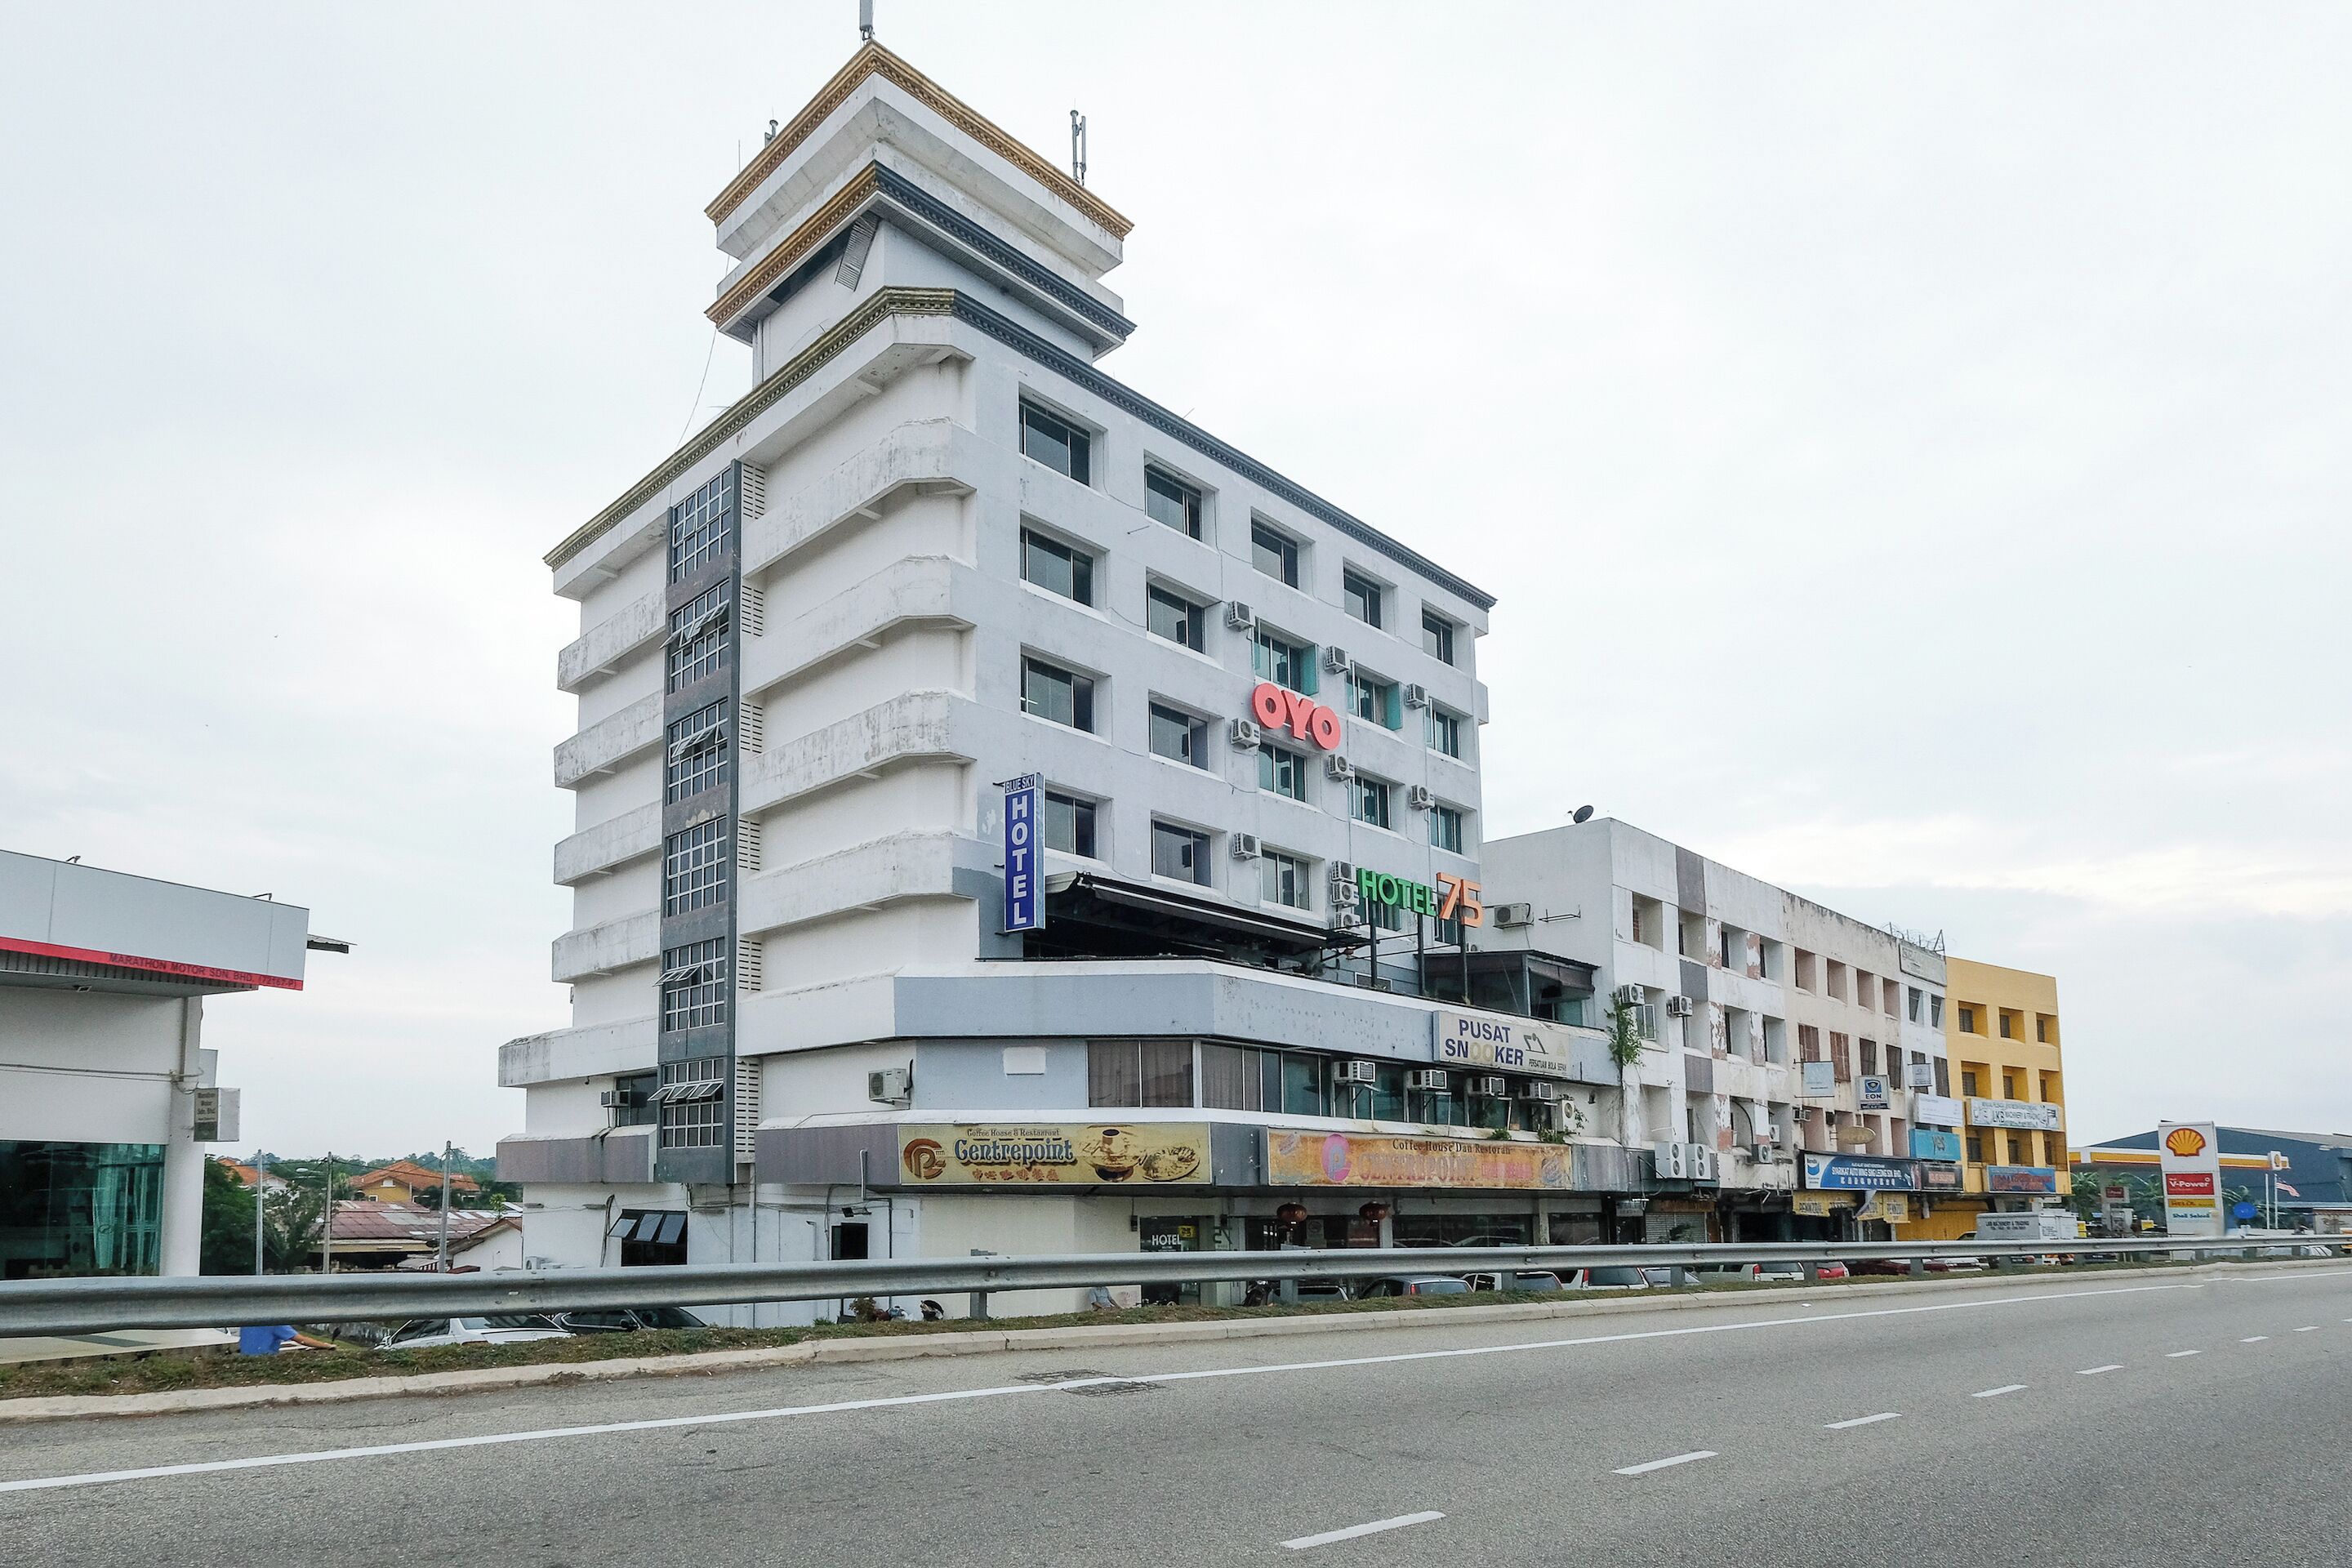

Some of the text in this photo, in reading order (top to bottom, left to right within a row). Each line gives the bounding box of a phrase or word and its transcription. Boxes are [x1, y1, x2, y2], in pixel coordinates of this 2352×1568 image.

[1252, 682, 1341, 751] OYO
[1005, 775, 1034, 794] BLUE SKY
[1011, 795, 1028, 925] HOTEL
[1356, 867, 1484, 928] HOTEL 75
[109, 954, 167, 970] MARATHON
[171, 962, 206, 975] MOTOR
[1459, 1019, 1511, 1043] PUSAT
[1445, 1038, 1524, 1066] SNOOKER
[967, 1129, 989, 1137] Coffee
[991, 1129, 1012, 1137] House
[955, 1138, 1074, 1165] Centrepoint
[1392, 1138, 1511, 1155] Coffee House Dan Restoran
[1152, 1234, 1182, 1246] HOTEL
